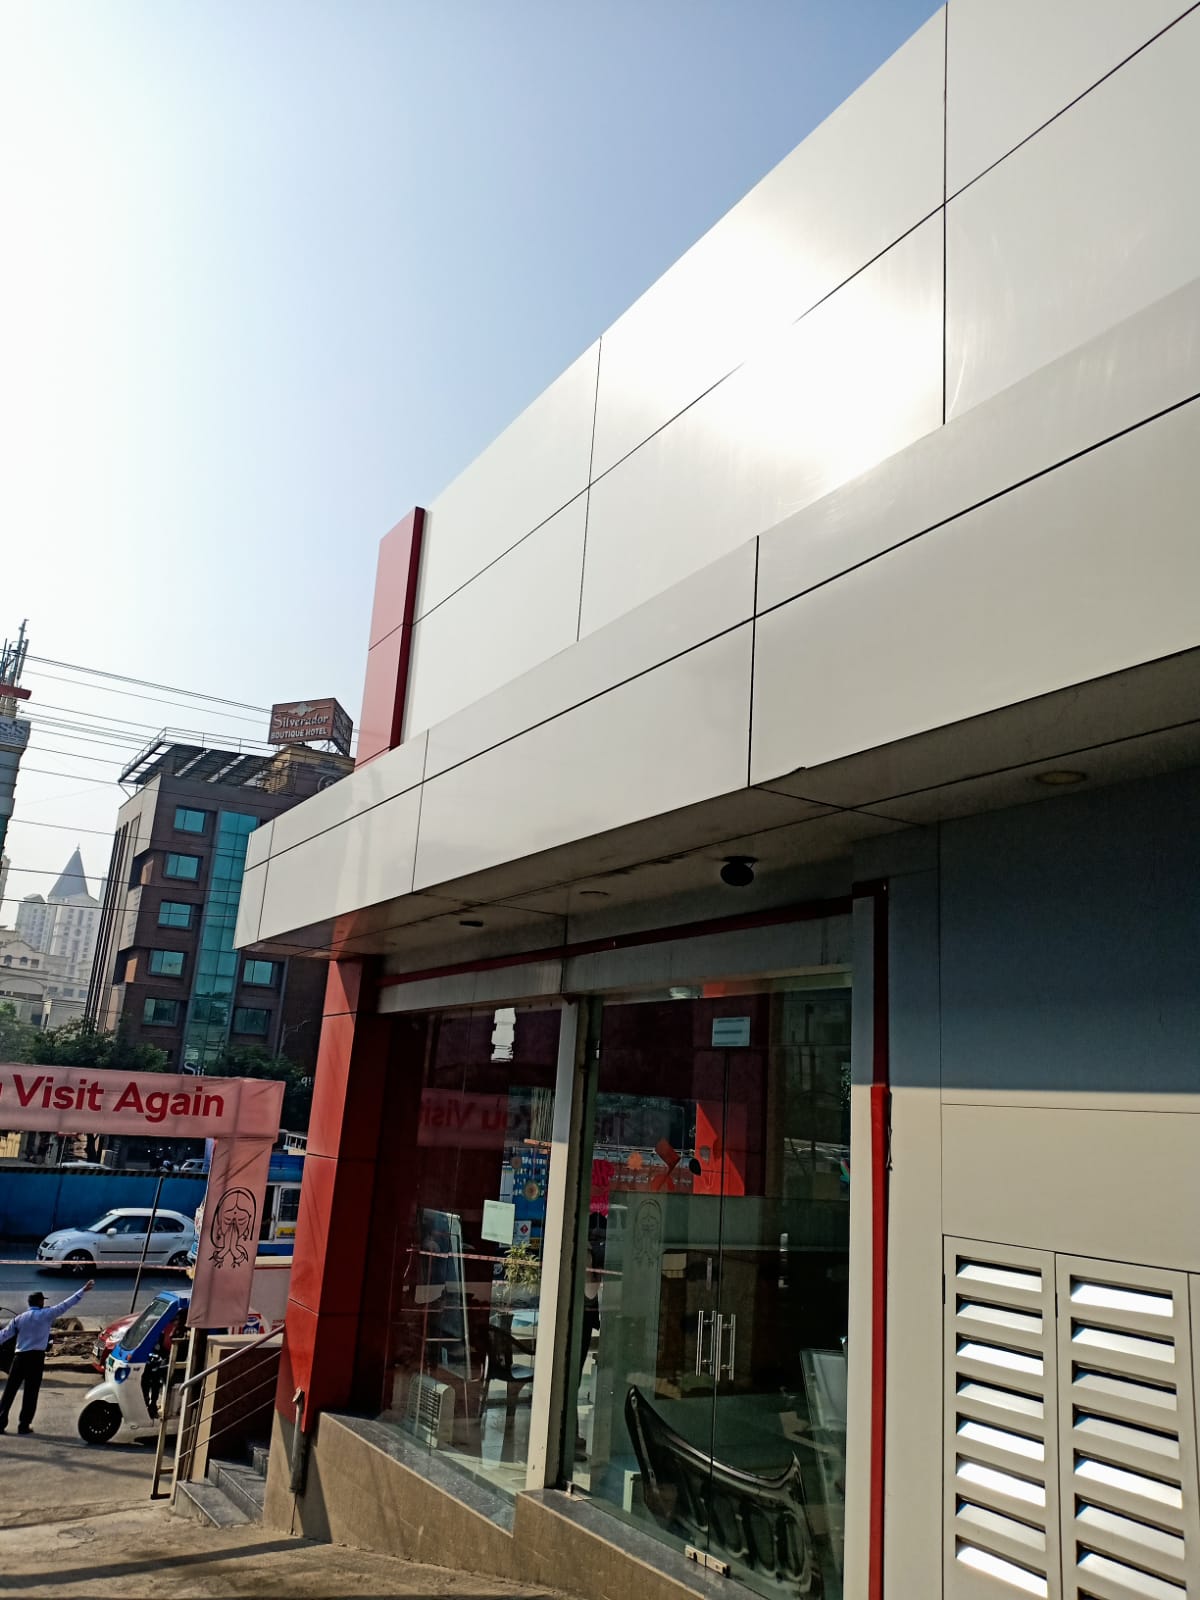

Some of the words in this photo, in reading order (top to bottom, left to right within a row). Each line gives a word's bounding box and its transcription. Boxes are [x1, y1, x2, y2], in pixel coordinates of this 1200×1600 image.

[273, 714, 329, 729] Silverador
[271, 729, 304, 739] BOUTIQUE
[305, 727, 327, 737] HOTEL
[13, 1074, 104, 1112] Visit
[113, 1081, 225, 1123] Again
